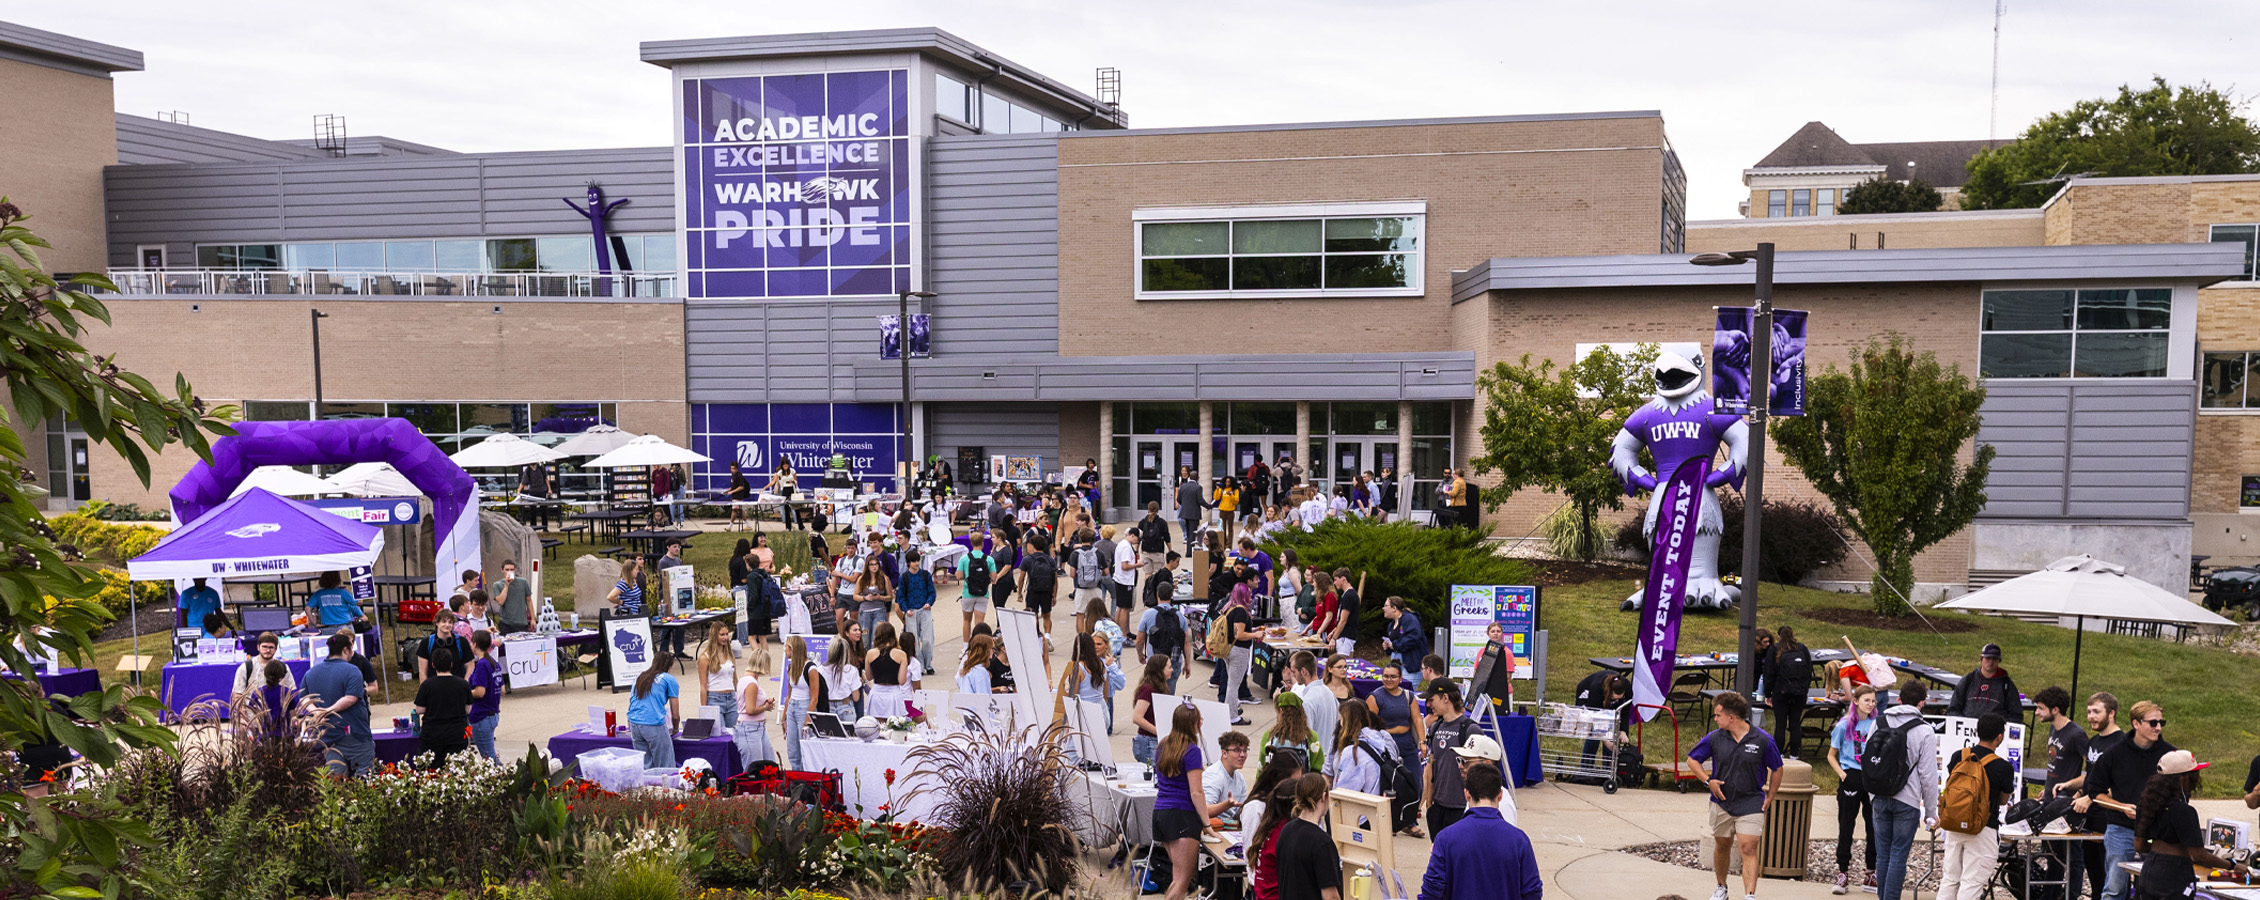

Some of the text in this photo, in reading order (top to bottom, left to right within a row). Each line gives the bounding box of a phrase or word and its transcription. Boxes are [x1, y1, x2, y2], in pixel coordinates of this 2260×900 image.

[713, 113, 879, 142] ACADEMIC
[714, 143, 879, 167] EXCELLENCE
[714, 177, 880, 204] WARHWK
[715, 206, 880, 249] PRIDE
[1794, 357, 1803, 410] Inclusivity
[1651, 421, 1701, 442] UW-W
[779, 440, 873, 452] University of Wisconsin
[779, 452, 875, 468] Whiteter
[363, 511, 387, 521] Fair
[212, 562, 226, 574] UW
[233, 558, 290, 573] WHITEWATER
[1651, 479, 1692, 662] EVENT TODAY
[1453, 603, 1489, 615] Greeks
[1460, 597, 1477, 607] MEET
[510, 659, 539, 676] cru
[1955, 721, 1977, 738] FEN
